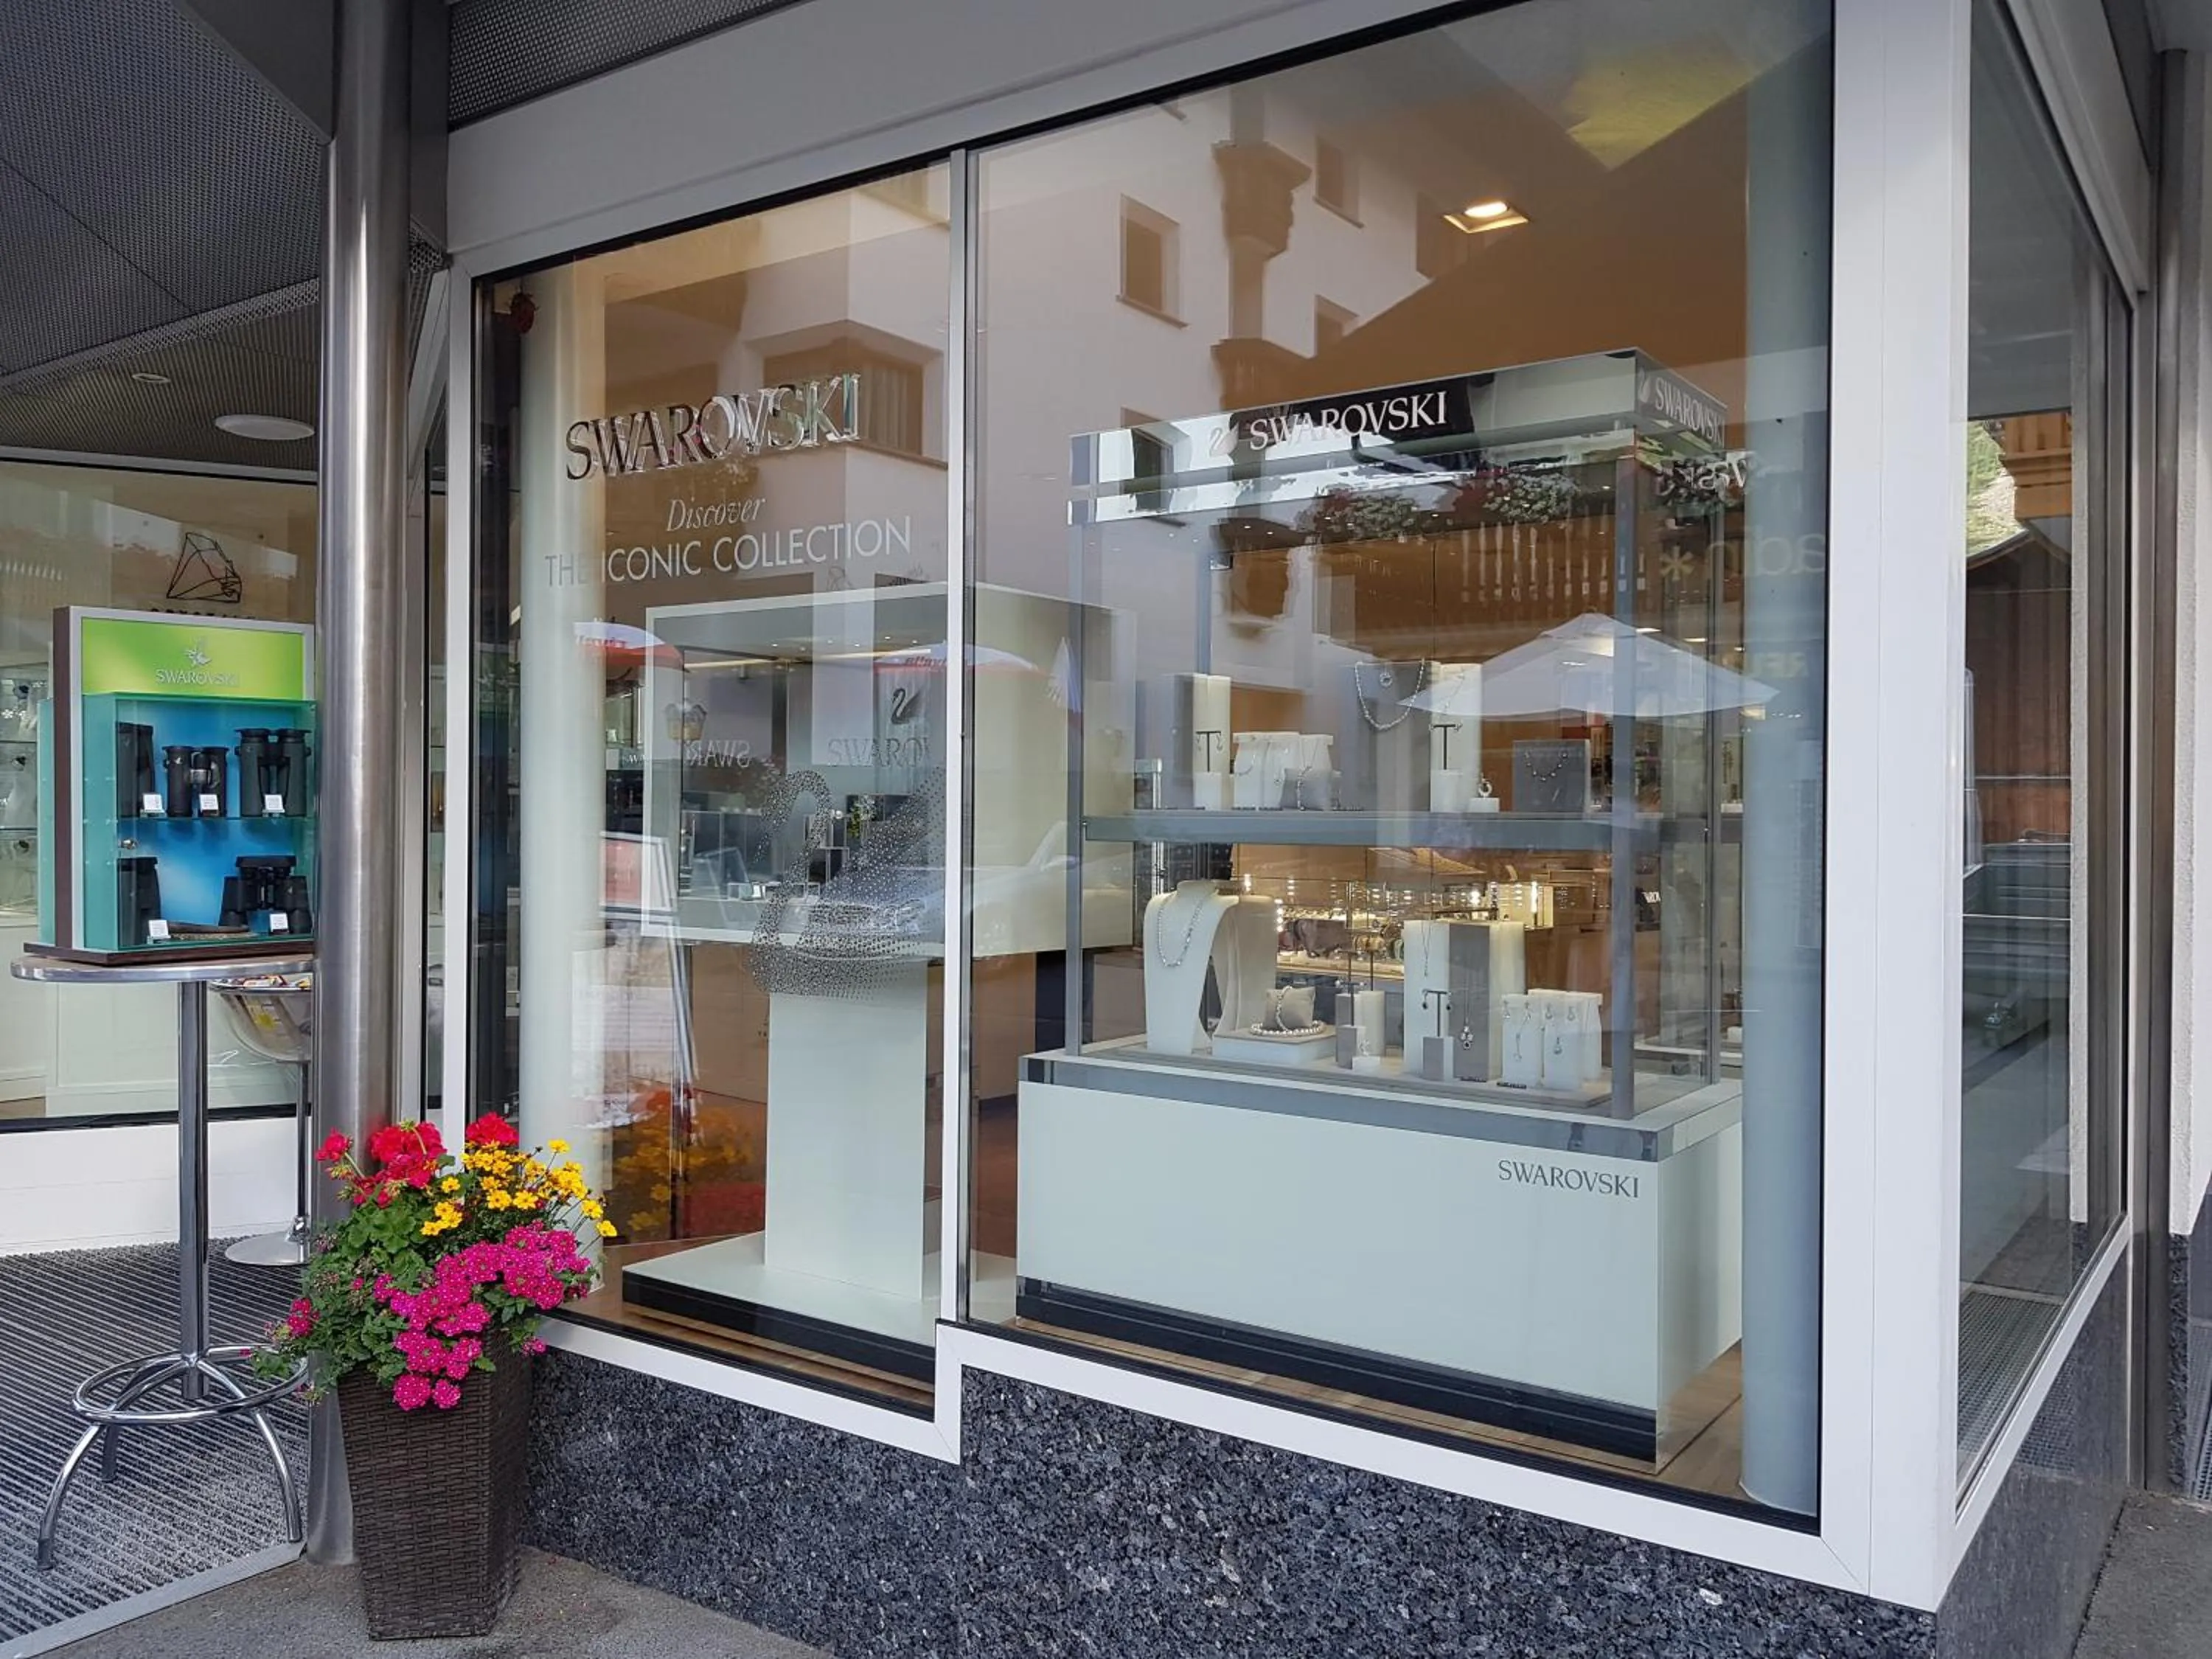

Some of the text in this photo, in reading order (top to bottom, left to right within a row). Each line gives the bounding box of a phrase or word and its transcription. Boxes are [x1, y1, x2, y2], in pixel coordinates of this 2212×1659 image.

[565, 372, 861, 481] SWAROVSKI
[1249, 391, 1447, 451] SWAROVSKI
[1655, 377, 1725, 448] SWAROVSKI
[665, 495, 766, 533] Discover
[601, 539, 703, 583] ICONIC
[712, 515, 912, 572] COLLECTION
[1498, 1159, 1640, 1198] SWAROVSKI
